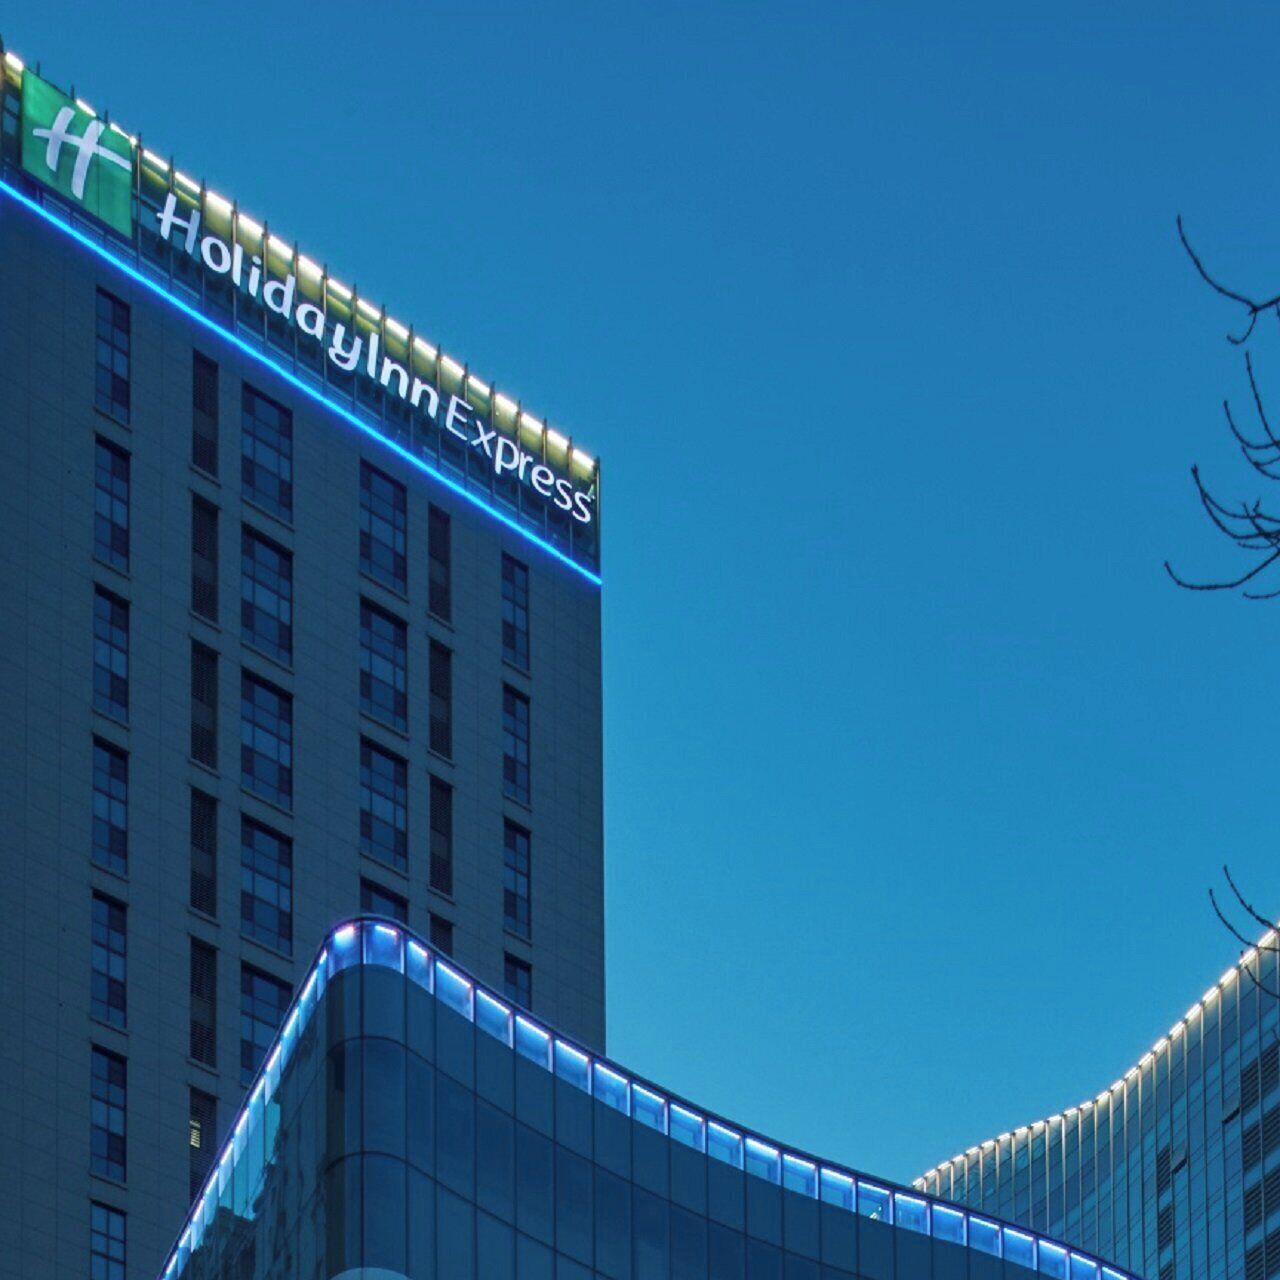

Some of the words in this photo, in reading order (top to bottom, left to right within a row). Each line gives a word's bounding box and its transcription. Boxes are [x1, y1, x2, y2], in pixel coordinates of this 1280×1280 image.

[157, 193, 362, 371] Holiday
[368, 333, 439, 418] Inn
[446, 395, 593, 524] Express
